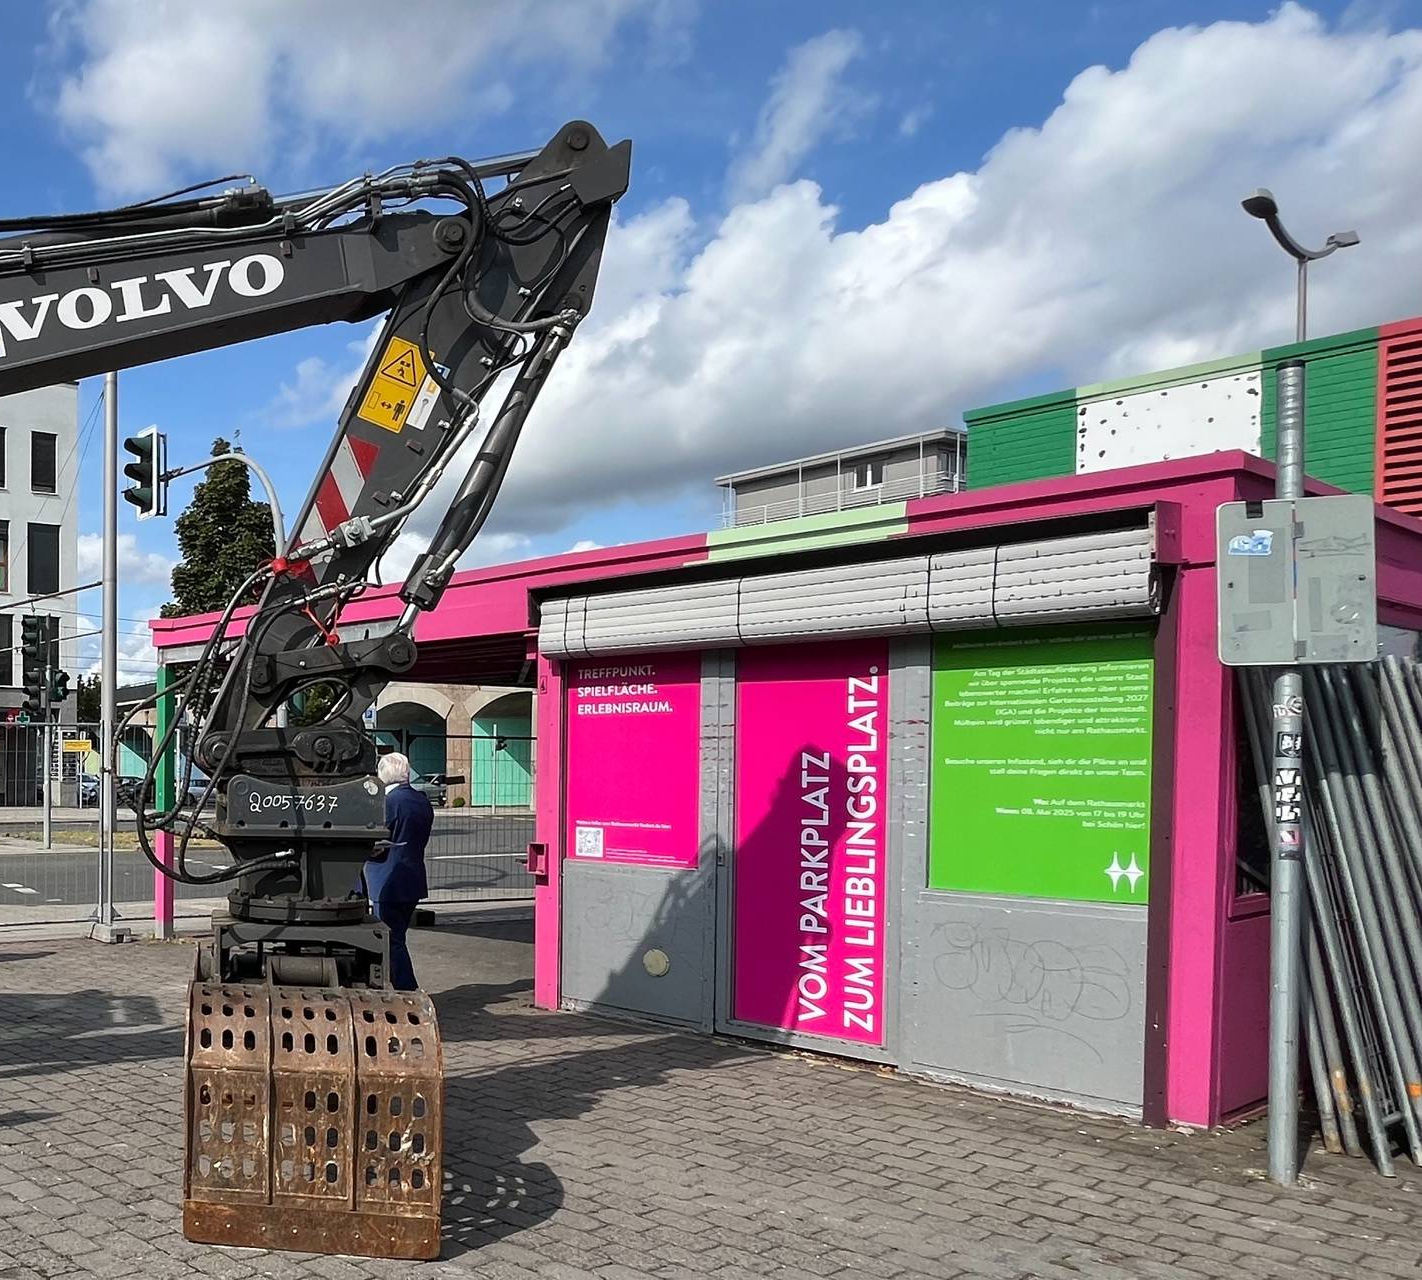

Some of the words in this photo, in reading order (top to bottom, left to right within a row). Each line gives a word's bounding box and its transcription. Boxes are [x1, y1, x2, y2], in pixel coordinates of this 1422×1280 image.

[578, 665, 656, 680] TREFFPUNKT.
[988, 670, 1001, 678] Tag
[578, 682, 658, 698] SPIELFLÄCHE.
[1125, 694, 1149, 702] 2027
[578, 701, 673, 715] ERLEBNISRAUM.
[249, 791, 338, 813] 20057637
[844, 666, 879, 947] LIEBLINGSPLATZ.
[1052, 809, 1075, 817] 2025
[1093, 810, 1102, 818] 17
[1128, 811, 1145, 819] Uhr
[799, 751, 830, 934] PARKPLATZ
[798, 944, 828, 1022] VOM
[843, 957, 875, 1034] ZUM
